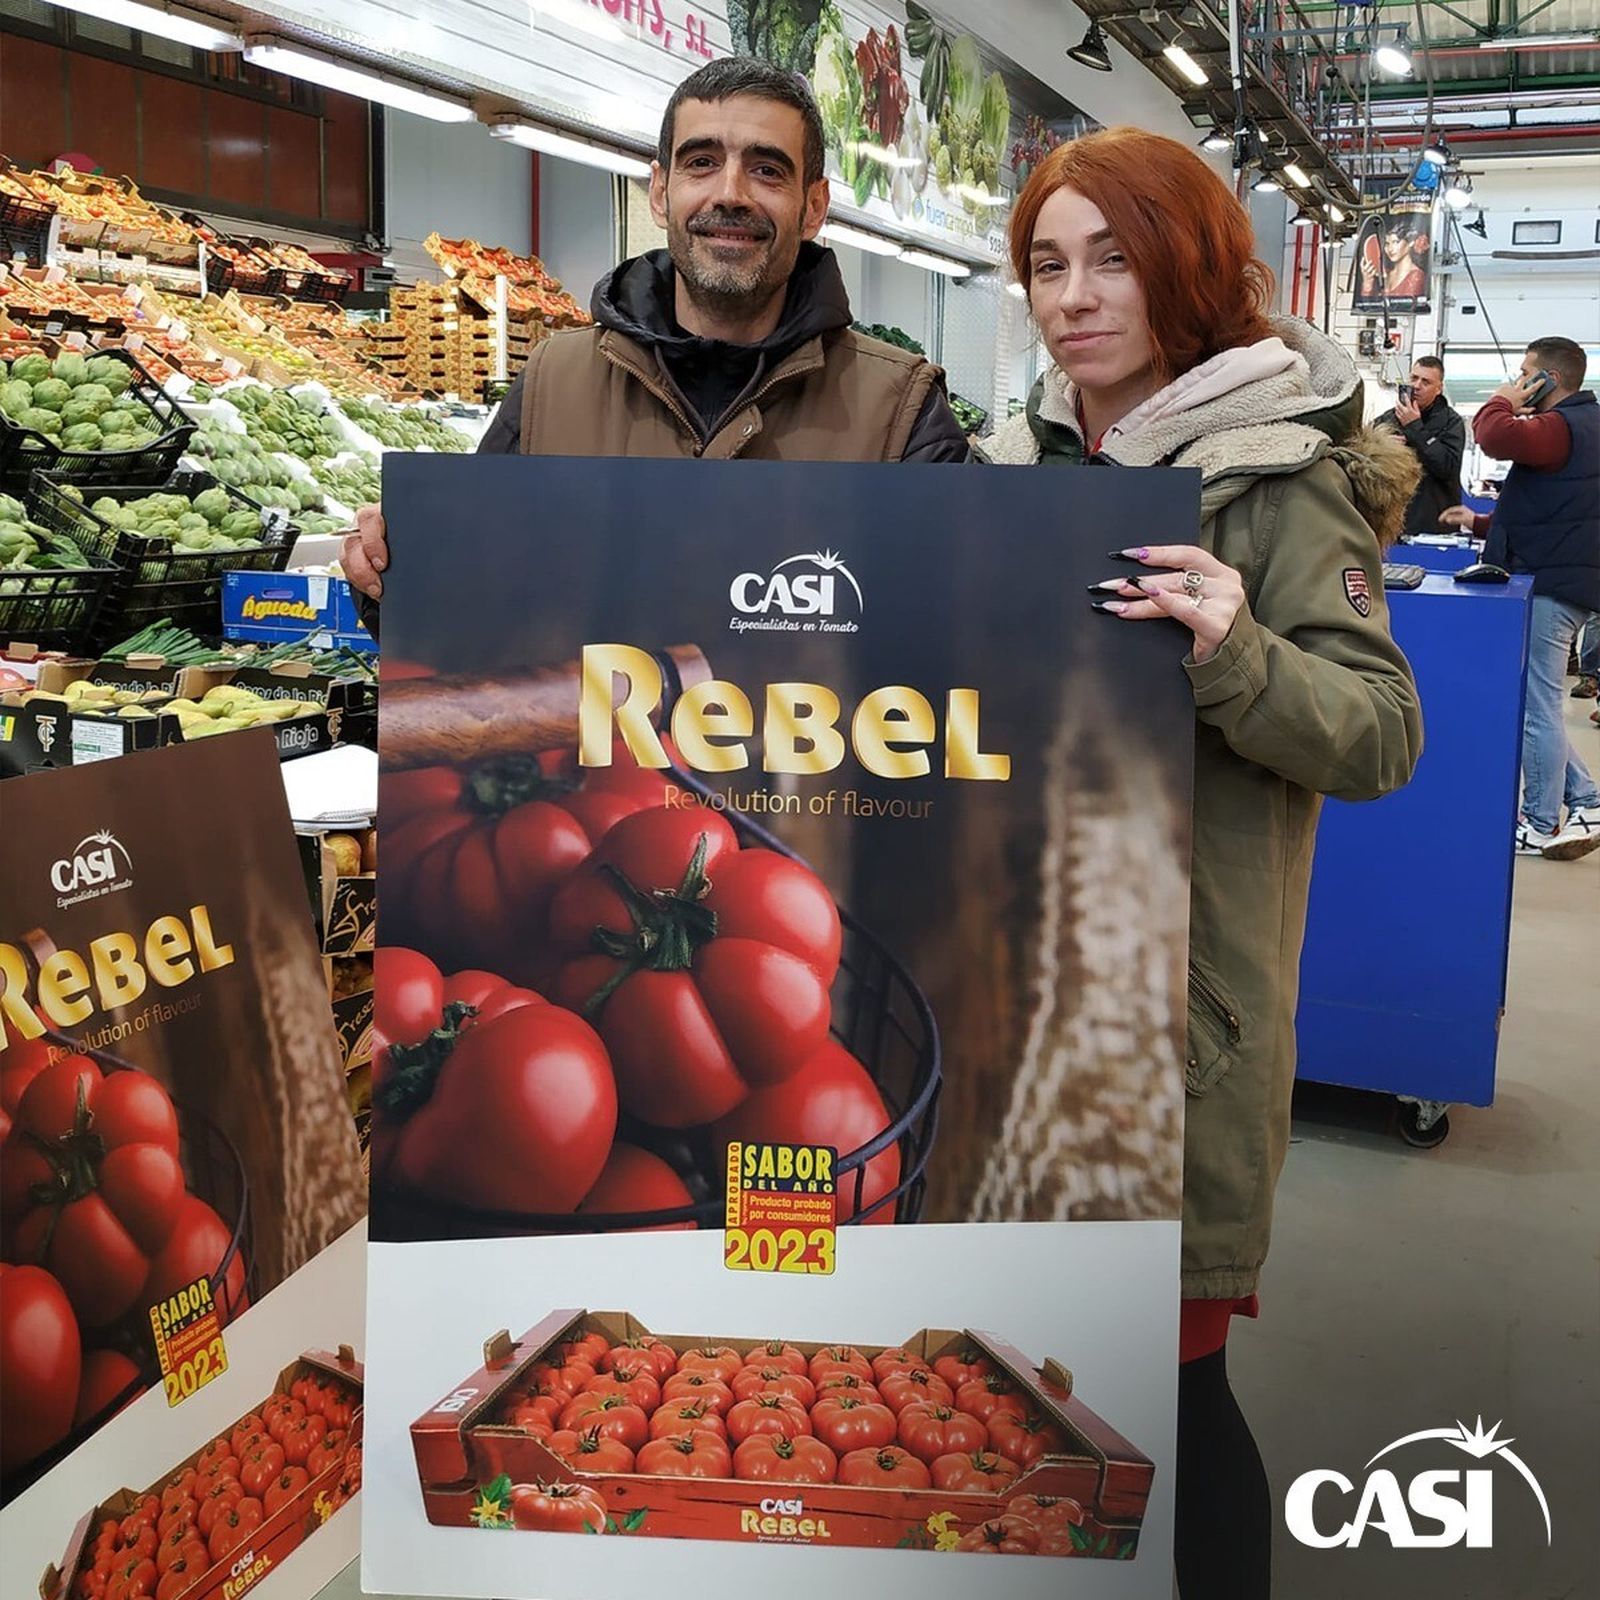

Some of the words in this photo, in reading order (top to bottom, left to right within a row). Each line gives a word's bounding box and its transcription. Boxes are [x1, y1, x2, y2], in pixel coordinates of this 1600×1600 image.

[730, 573, 834, 615] CASI
[729, 617, 801, 634] Especialistas
[802, 622, 817, 632] en
[818, 619, 859, 633] Tomate
[281, 723, 319, 749] Rioja
[664, 785, 800, 815] Revolution
[808, 790, 838, 815] of
[842, 790, 935, 819] flavour
[50, 848, 117, 893] CASI
[47, 1021, 133, 1067] Revolution
[135, 1008, 151, 1032] of
[152, 993, 202, 1026] flavour
[743, 1144, 833, 1181] SABOR
[728, 1144, 740, 1225] APROBADO
[743, 1179, 778, 1190] DEL
[792, 1180, 834, 1194] AÑO
[749, 1195, 792, 1208] Producto
[793, 1198, 832, 1211] probado
[749, 1210, 765, 1221] por
[766, 1210, 832, 1224] consumidores
[726, 1228, 835, 1275] 2023
[160, 1278, 212, 1330] SABOR
[165, 1336, 228, 1408] 2023
[760, 1498, 803, 1515] CASI
